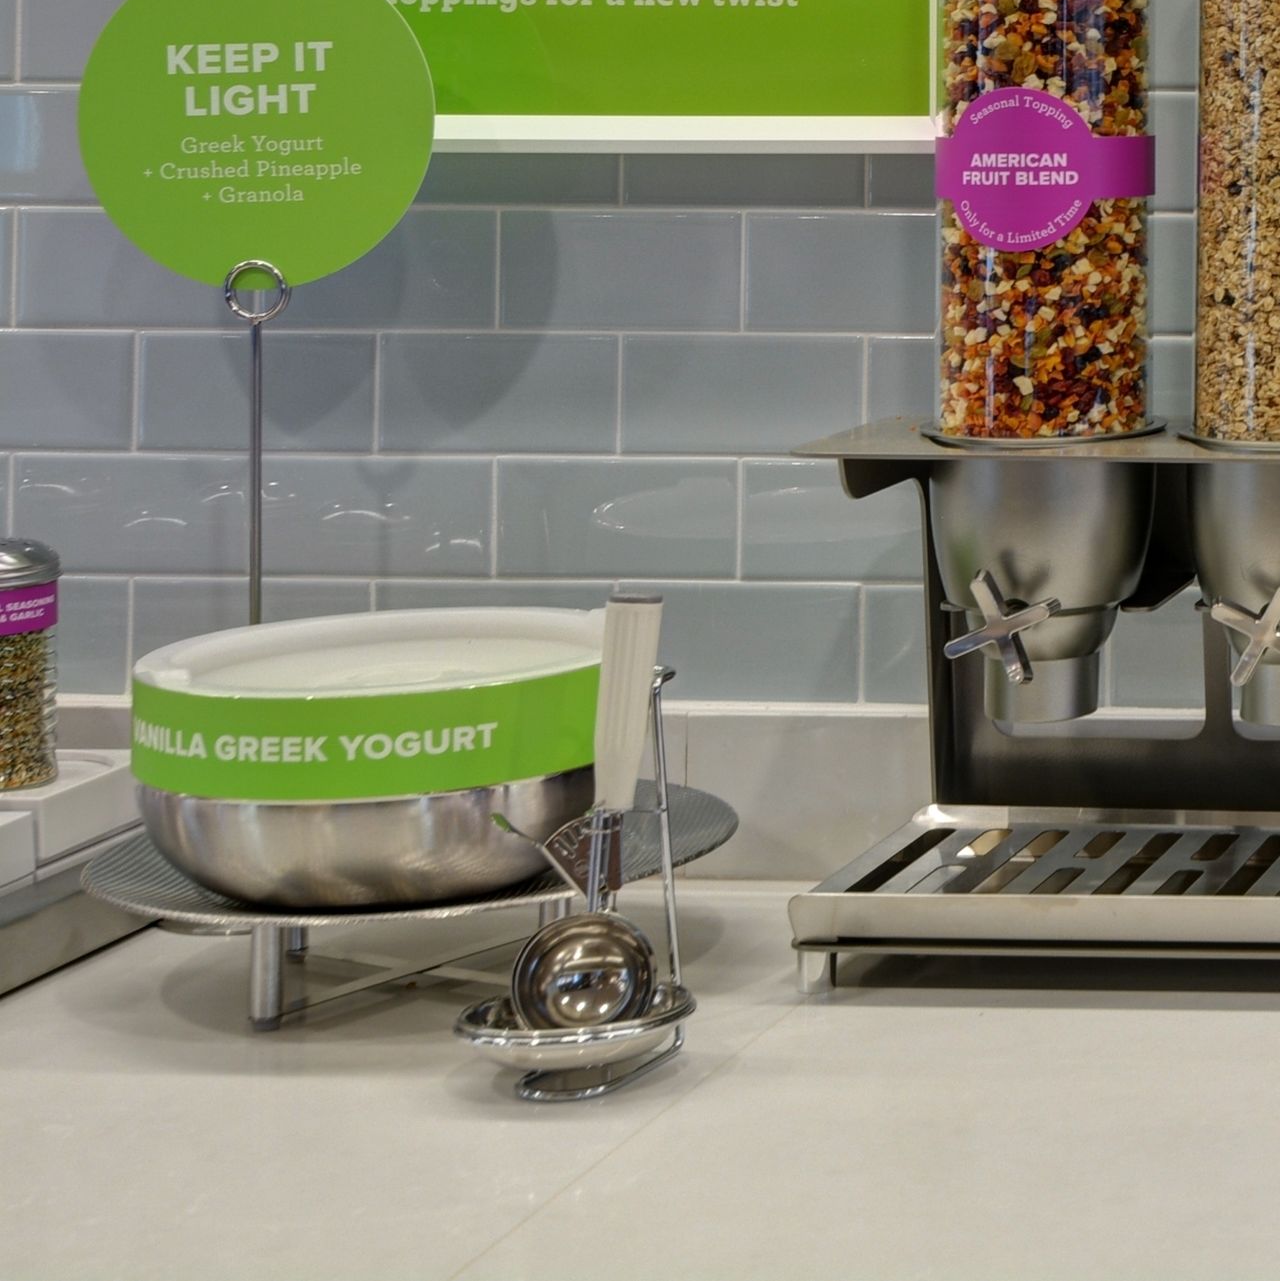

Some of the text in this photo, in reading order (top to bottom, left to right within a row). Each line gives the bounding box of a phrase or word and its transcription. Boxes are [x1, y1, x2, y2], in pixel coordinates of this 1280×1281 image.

[166, 40, 334, 75] KEEP IT
[184, 83, 317, 117] LIGHT
[970, 95, 1074, 130] Seasonal Topping
[179, 134, 324, 156] Greek Yogurt
[143, 156, 362, 180] + Crushed Pineapple
[970, 152, 1068, 168] AMERICAN
[962, 170, 1079, 186] FRUIT BLEND
[201, 183, 305, 204] + Granola
[960, 199, 1083, 244] Only for a Limited Time
[9, 608, 46, 622] GARLIC
[134, 716, 498, 763] VANILLA GREEK YOGURT
